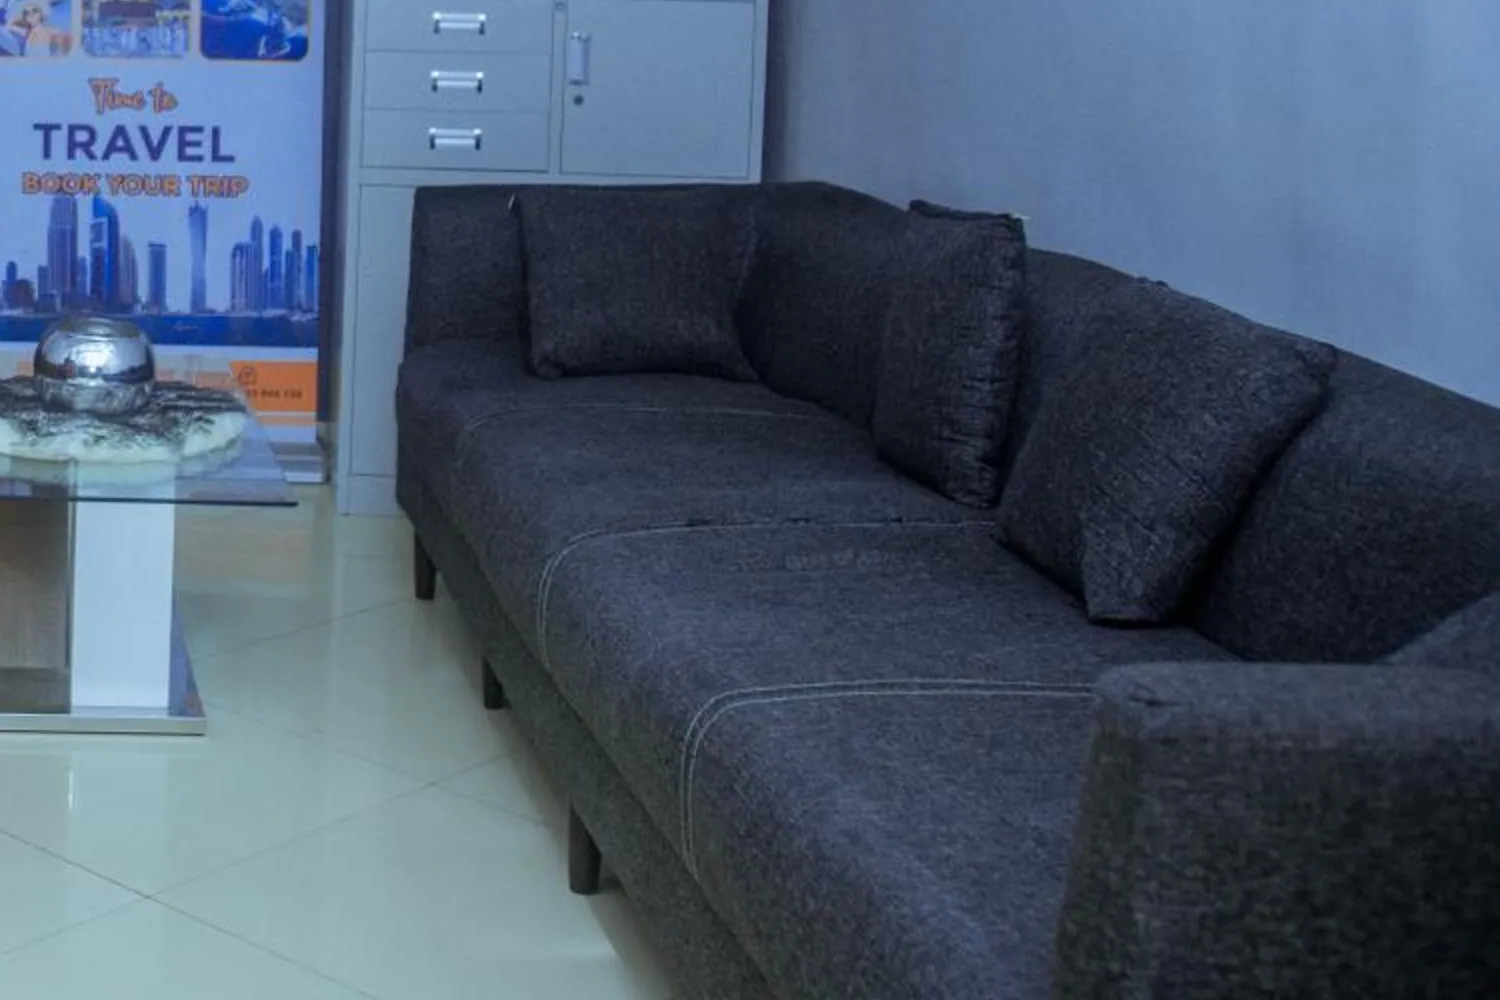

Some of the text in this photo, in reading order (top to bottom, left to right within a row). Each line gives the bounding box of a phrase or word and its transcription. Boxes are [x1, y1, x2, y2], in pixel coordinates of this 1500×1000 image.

[88, 77, 180, 115] Time to
[33, 122, 236, 163] TRAVEL
[21, 171, 250, 198] BOOK YOUR TRIP
